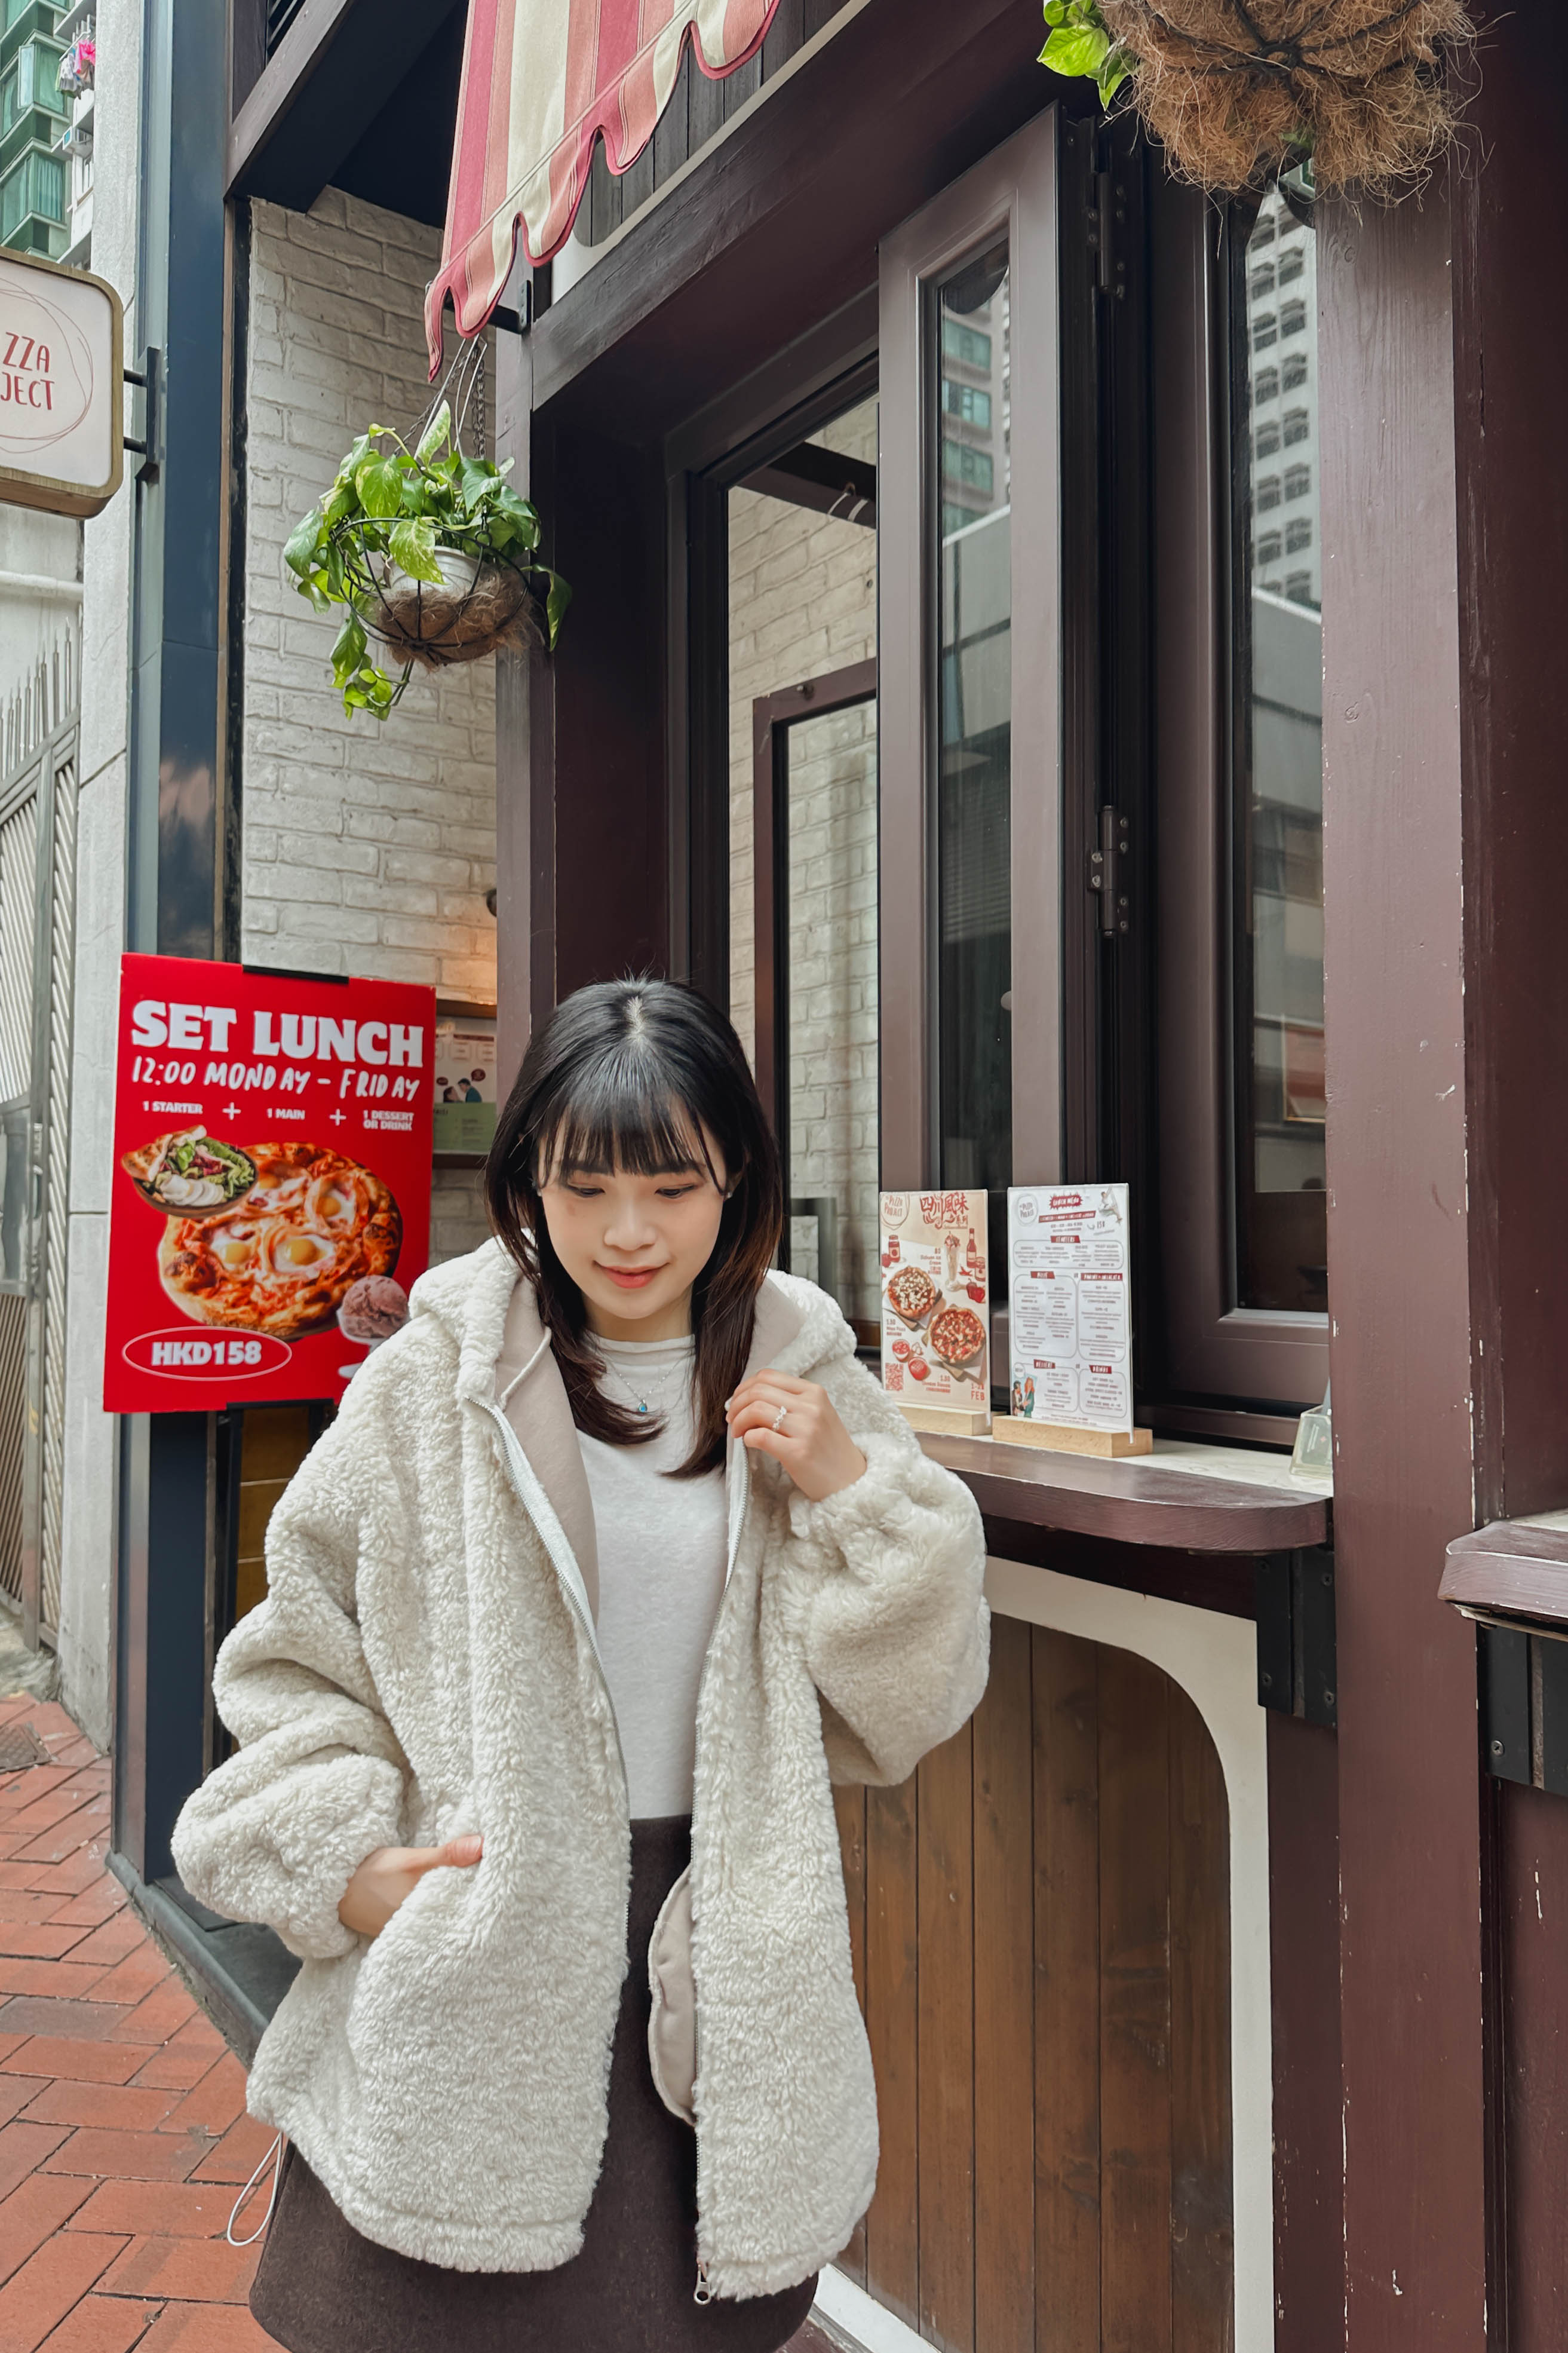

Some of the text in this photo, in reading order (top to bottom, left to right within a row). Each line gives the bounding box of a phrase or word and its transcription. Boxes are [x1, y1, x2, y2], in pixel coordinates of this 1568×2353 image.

[131, 1000, 237, 1052] SET
[253, 1010, 424, 1067] LUNCH
[131, 1056, 197, 1086] 12:00
[203, 1062, 311, 1095] MONDAY
[339, 1068, 420, 1102] FRIDAY
[143, 1101, 149, 1111] 1
[152, 1101, 203, 1114] STARTER
[267, 1108, 273, 1119] 1
[275, 1108, 305, 1120] MAIN
[363, 1110, 369, 1120] 1
[371, 1110, 415, 1122] DESSERT
[363, 1120, 413, 1131] OR DRINK
[151, 1341, 262, 1366] HKD158
[971, 1390, 985, 1401] FEB
